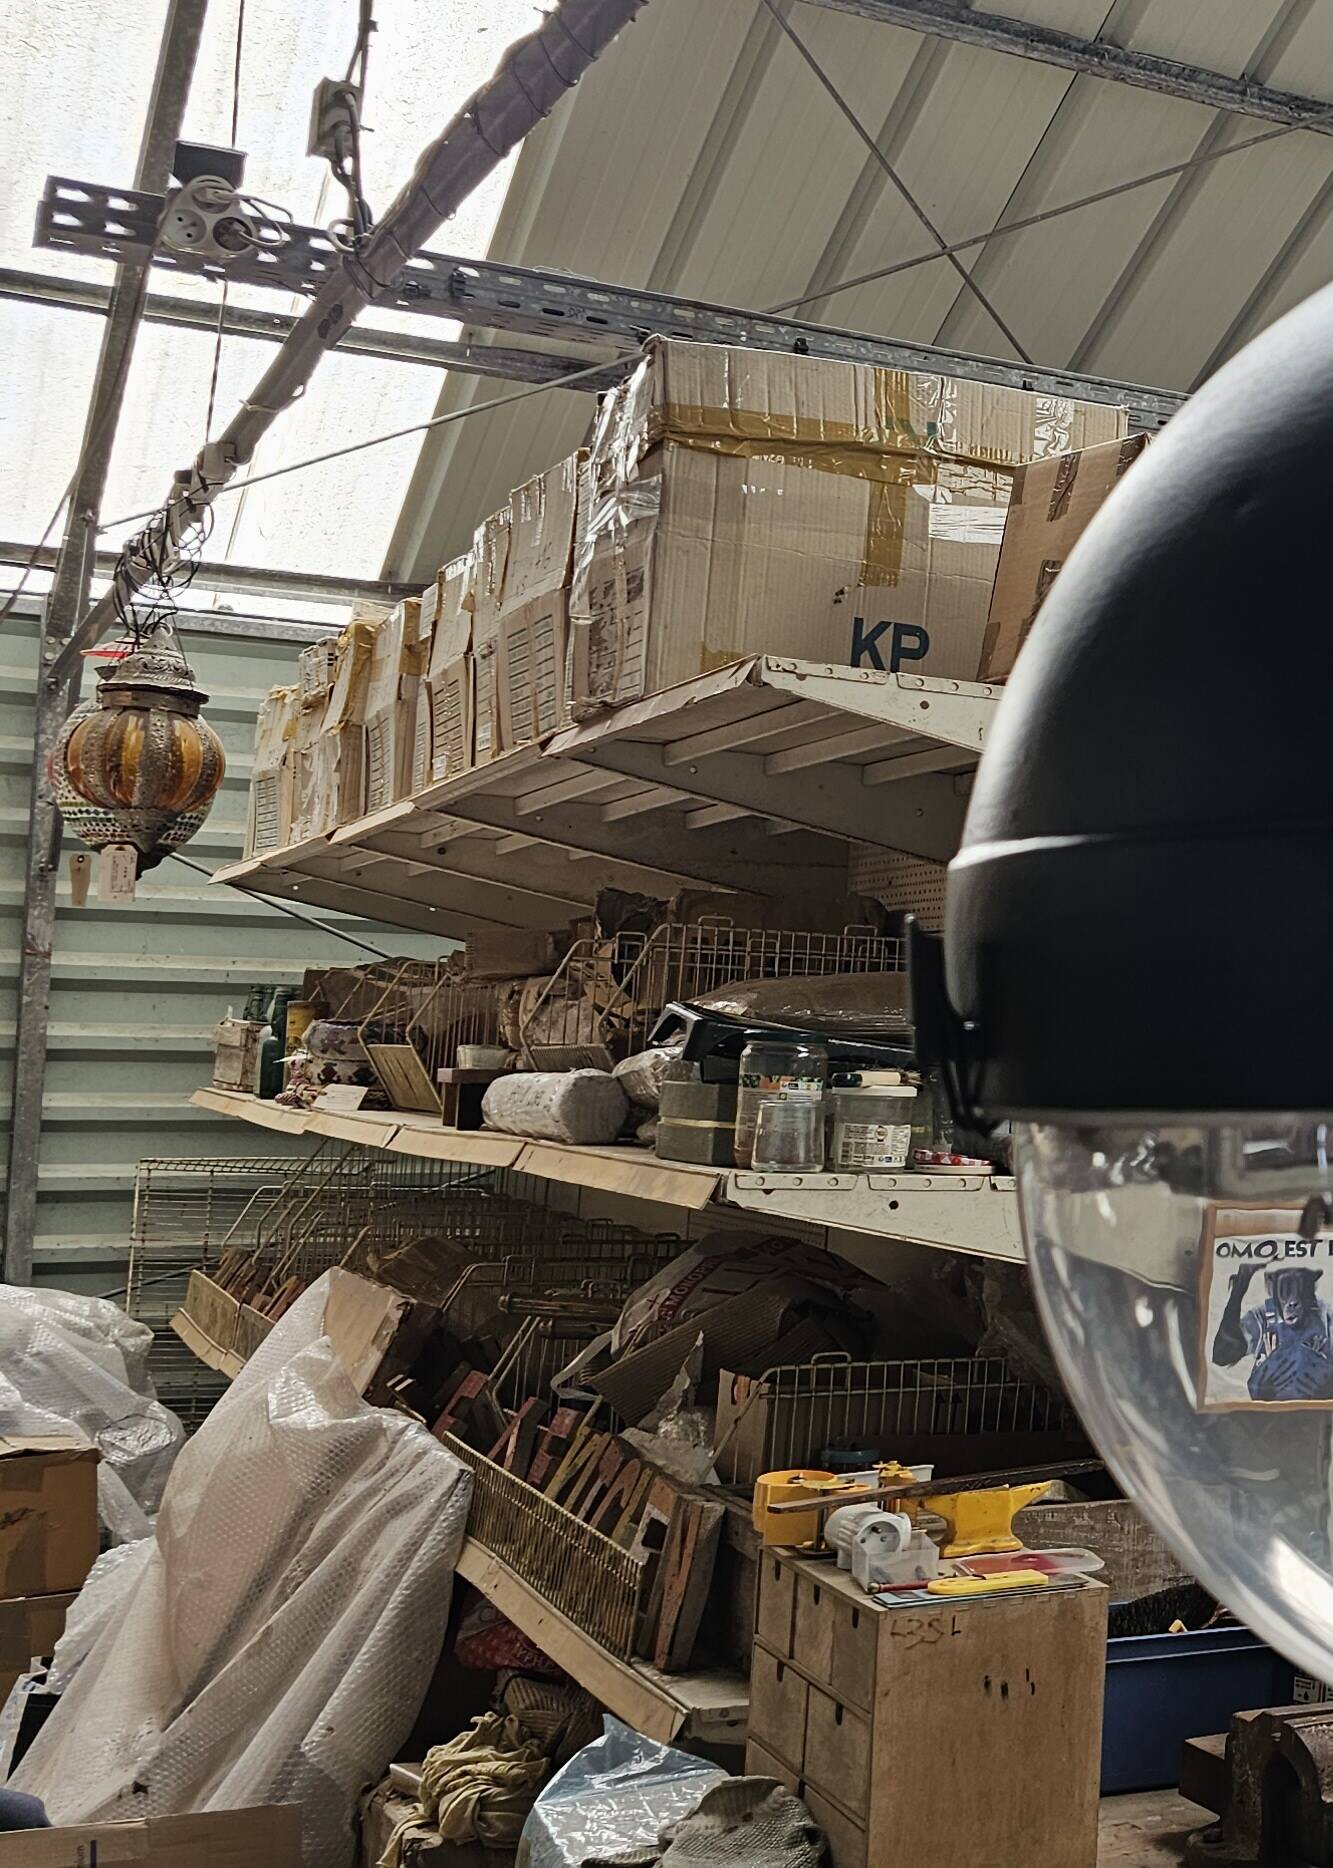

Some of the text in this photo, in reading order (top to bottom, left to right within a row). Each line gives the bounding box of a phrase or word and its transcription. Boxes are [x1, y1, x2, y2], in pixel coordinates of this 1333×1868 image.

[850, 616, 930, 673] KP
[1216, 1240, 1278, 1259] OMO
[1285, 1240, 1323, 1258] EST
